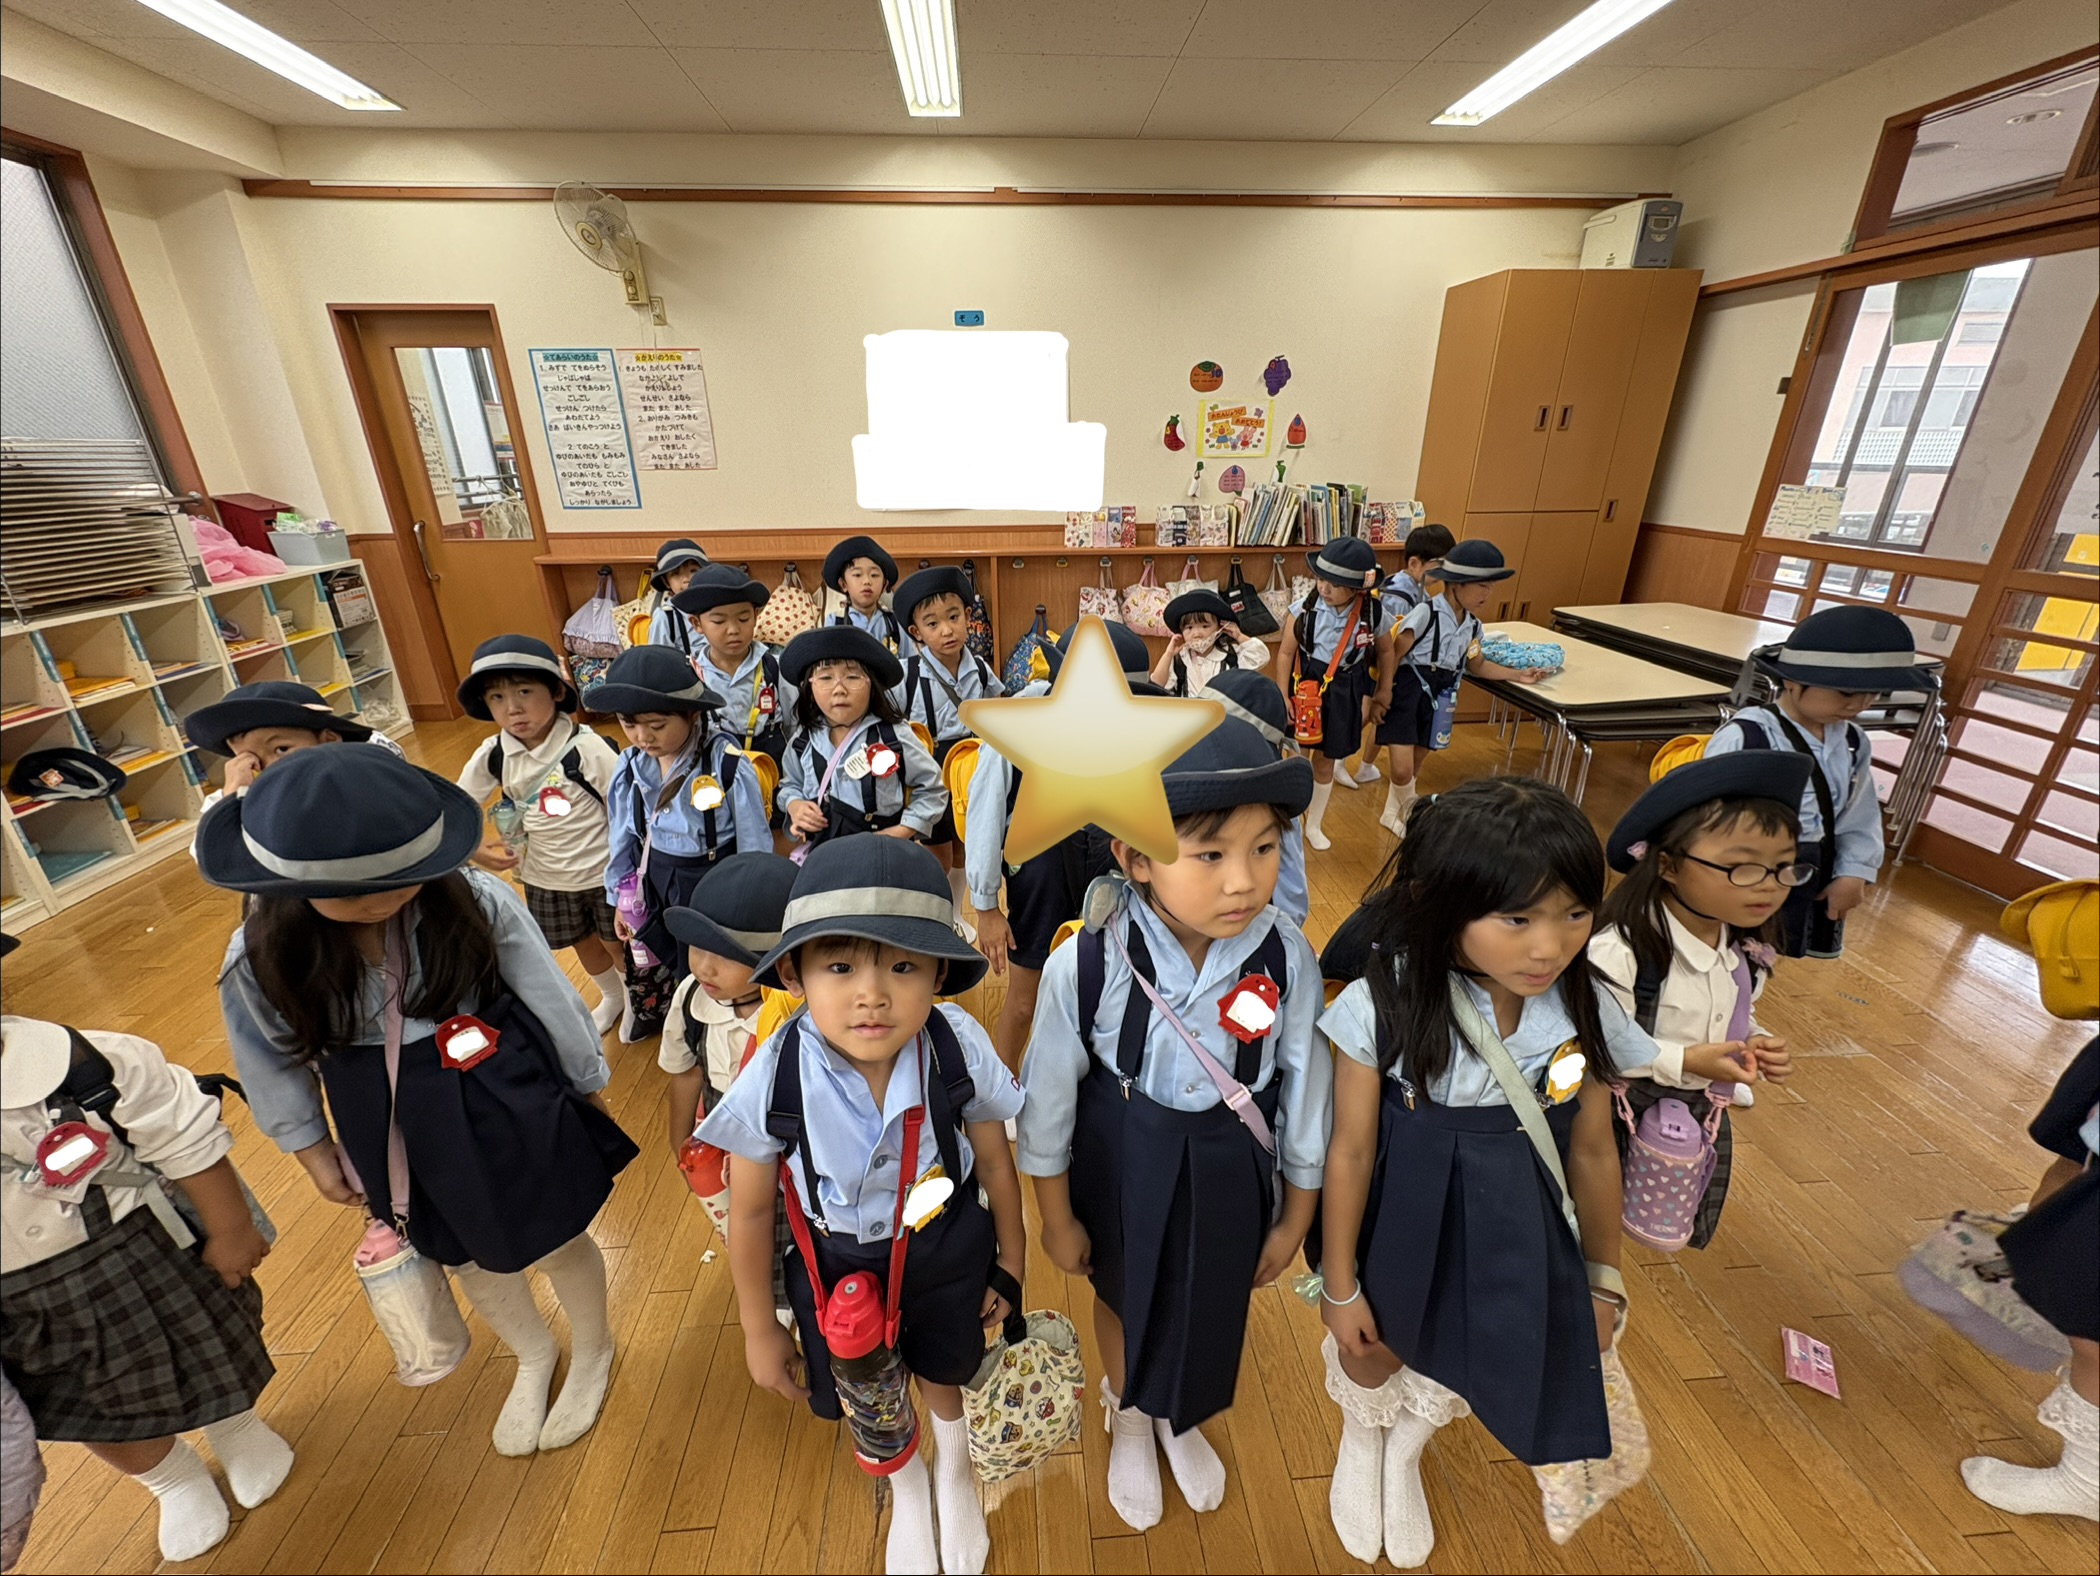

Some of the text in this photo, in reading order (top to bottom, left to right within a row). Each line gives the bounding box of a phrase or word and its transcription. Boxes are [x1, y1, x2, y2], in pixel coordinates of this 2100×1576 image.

[640, 394, 664, 402] せんせい
[582, 404, 607, 412] つけたら
